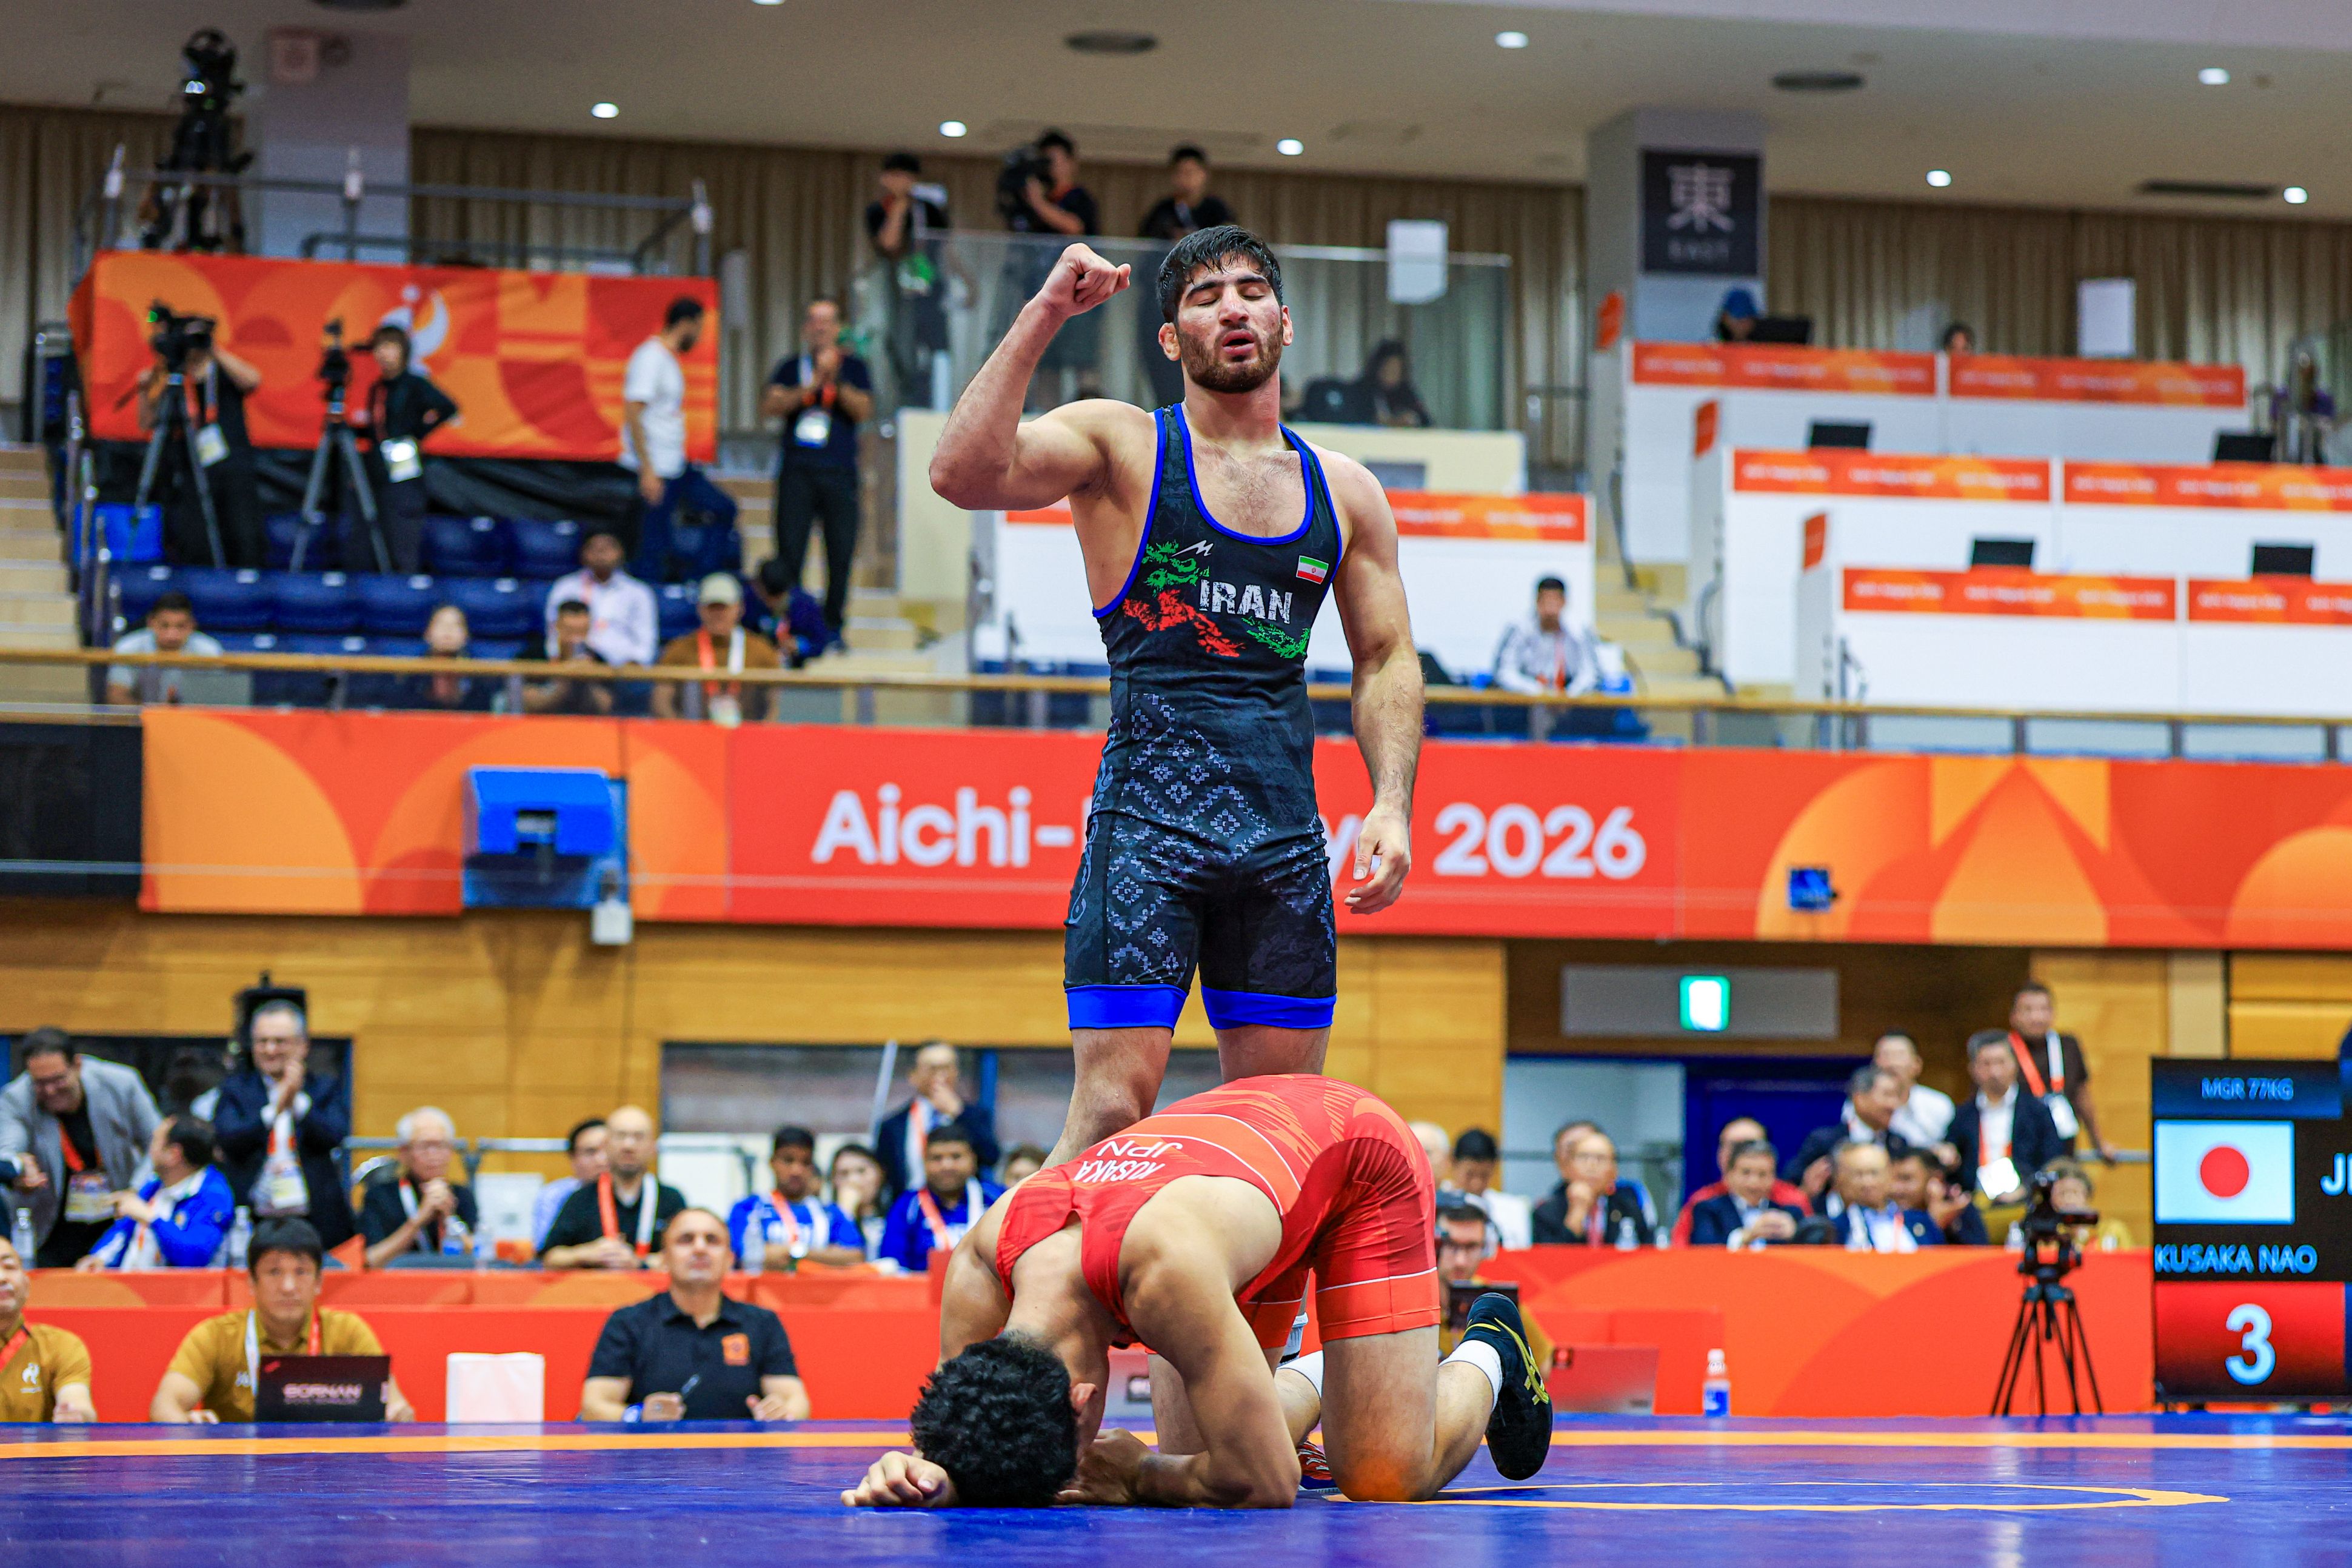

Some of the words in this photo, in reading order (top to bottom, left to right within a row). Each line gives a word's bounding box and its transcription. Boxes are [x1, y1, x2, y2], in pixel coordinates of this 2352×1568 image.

[1666, 162, 1736, 234] 東
[1199, 579, 1293, 624] IRAN
[1433, 802, 1647, 879] 2026
[2202, 1077, 2245, 1100] MGR
[2247, 1077, 2294, 1101] 77KG
[1097, 1140, 1183, 1158] JPN
[1074, 1160, 1165, 1183] KUSAKA
[2154, 1243, 2254, 1273] KUSAKA
[2258, 1244, 2318, 1274] NAO
[2225, 1303, 2276, 1386] 3
